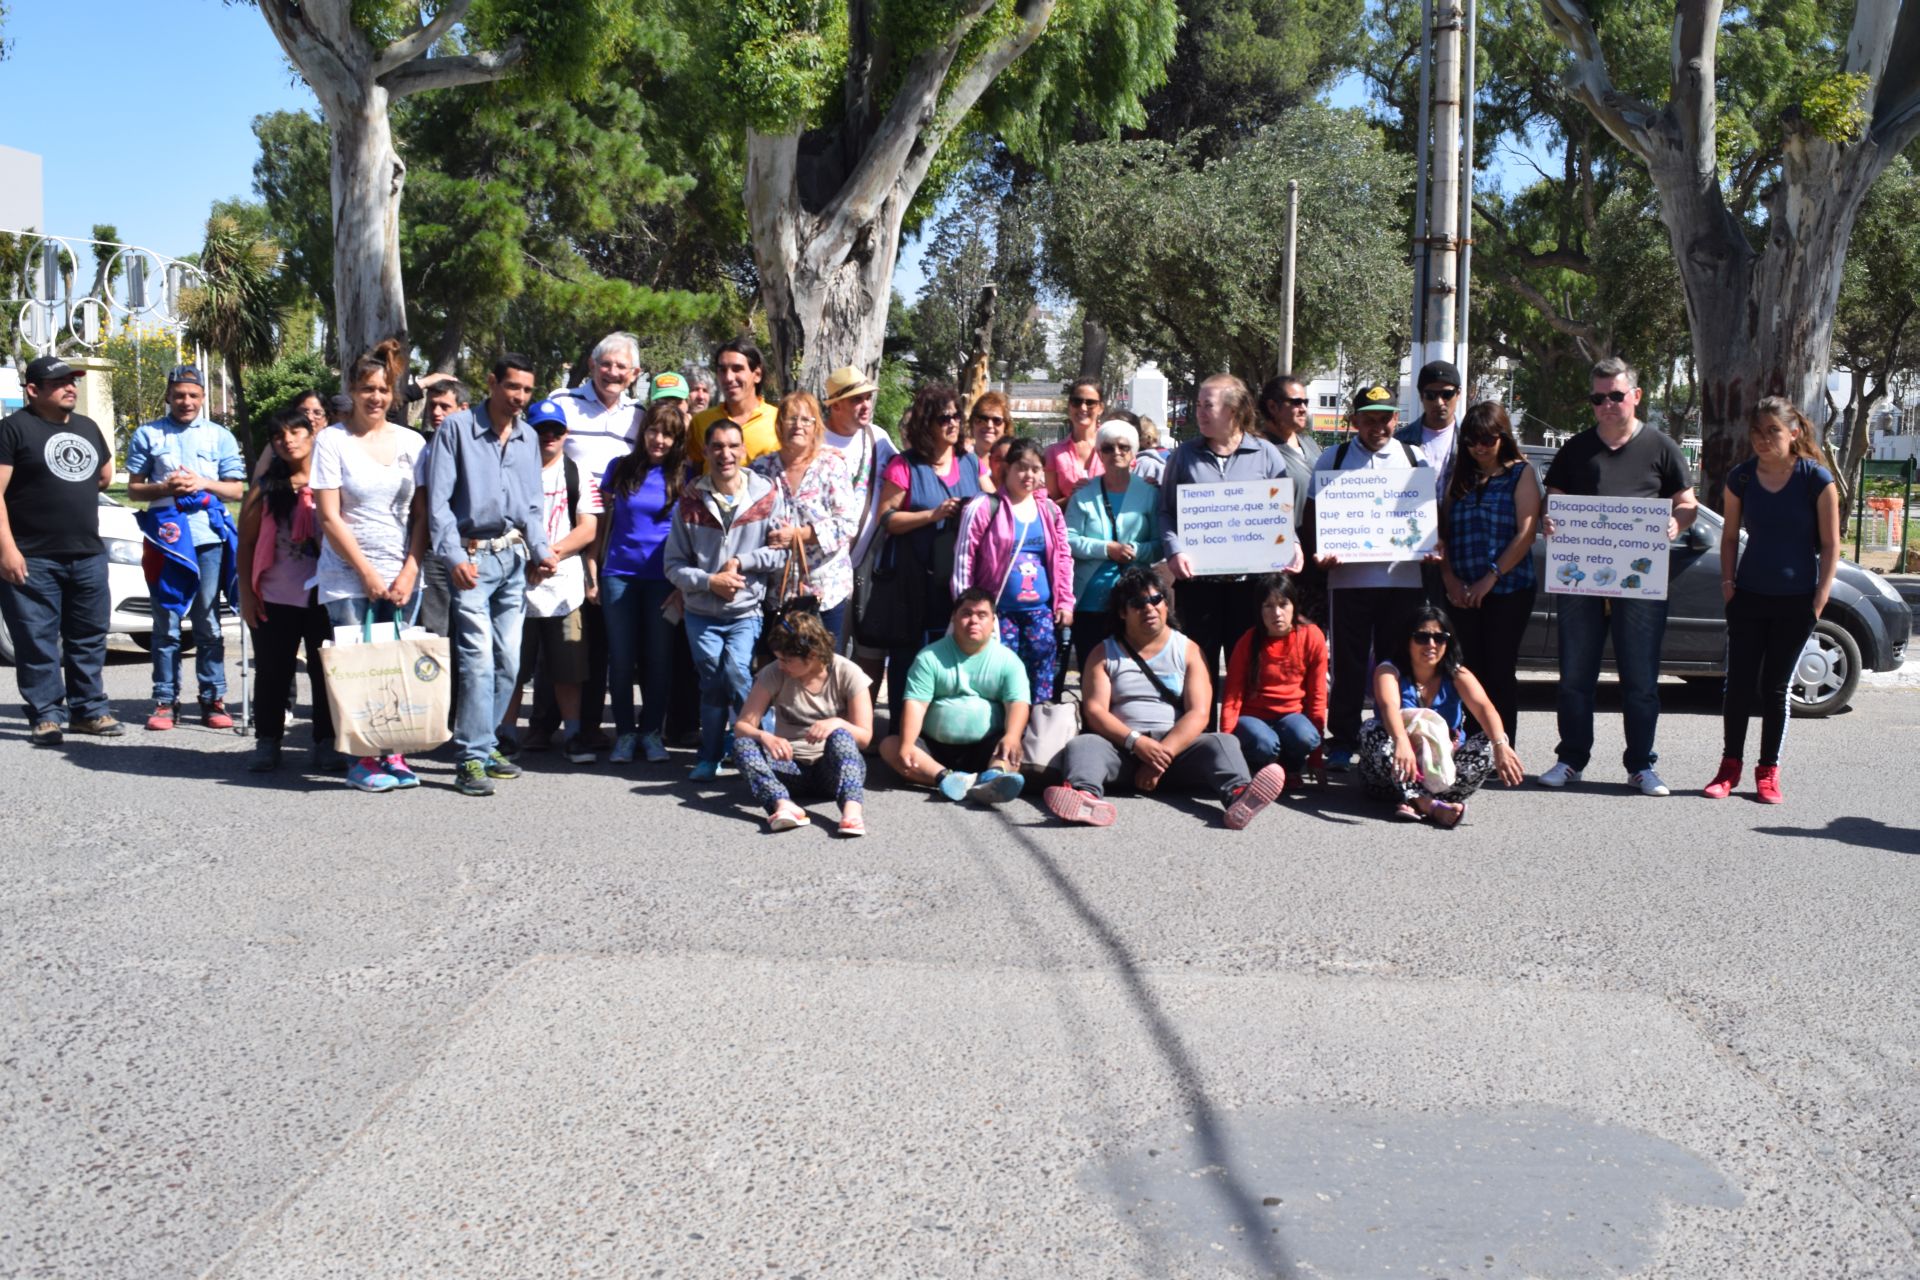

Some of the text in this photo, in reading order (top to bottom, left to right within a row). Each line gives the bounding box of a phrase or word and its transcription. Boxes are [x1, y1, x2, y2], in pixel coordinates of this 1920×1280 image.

[1320, 474, 1388, 486] Un pequeño
[1181, 487, 1244, 498] Tienen que
[1325, 489, 1419, 499] fantasma blanco
[1269, 502, 1279, 510] se
[1550, 501, 1670, 517] Discapacitado sos vos,
[1320, 510, 1340, 519] que
[1347, 510, 1364, 518] era
[1371, 509, 1381, 518] la
[1183, 515, 1288, 532] pongan de acuerdo
[1552, 518, 1660, 533] no me conoces no
[1392, 526, 1405, 535] un
[1185, 536, 1198, 547] los
[1203, 534, 1228, 544] locos
[1551, 533, 1581, 544] sabes
[1619, 539, 1650, 549] como
[1652, 542, 1667, 552] yo
[1552, 552, 1614, 565] vade retro
